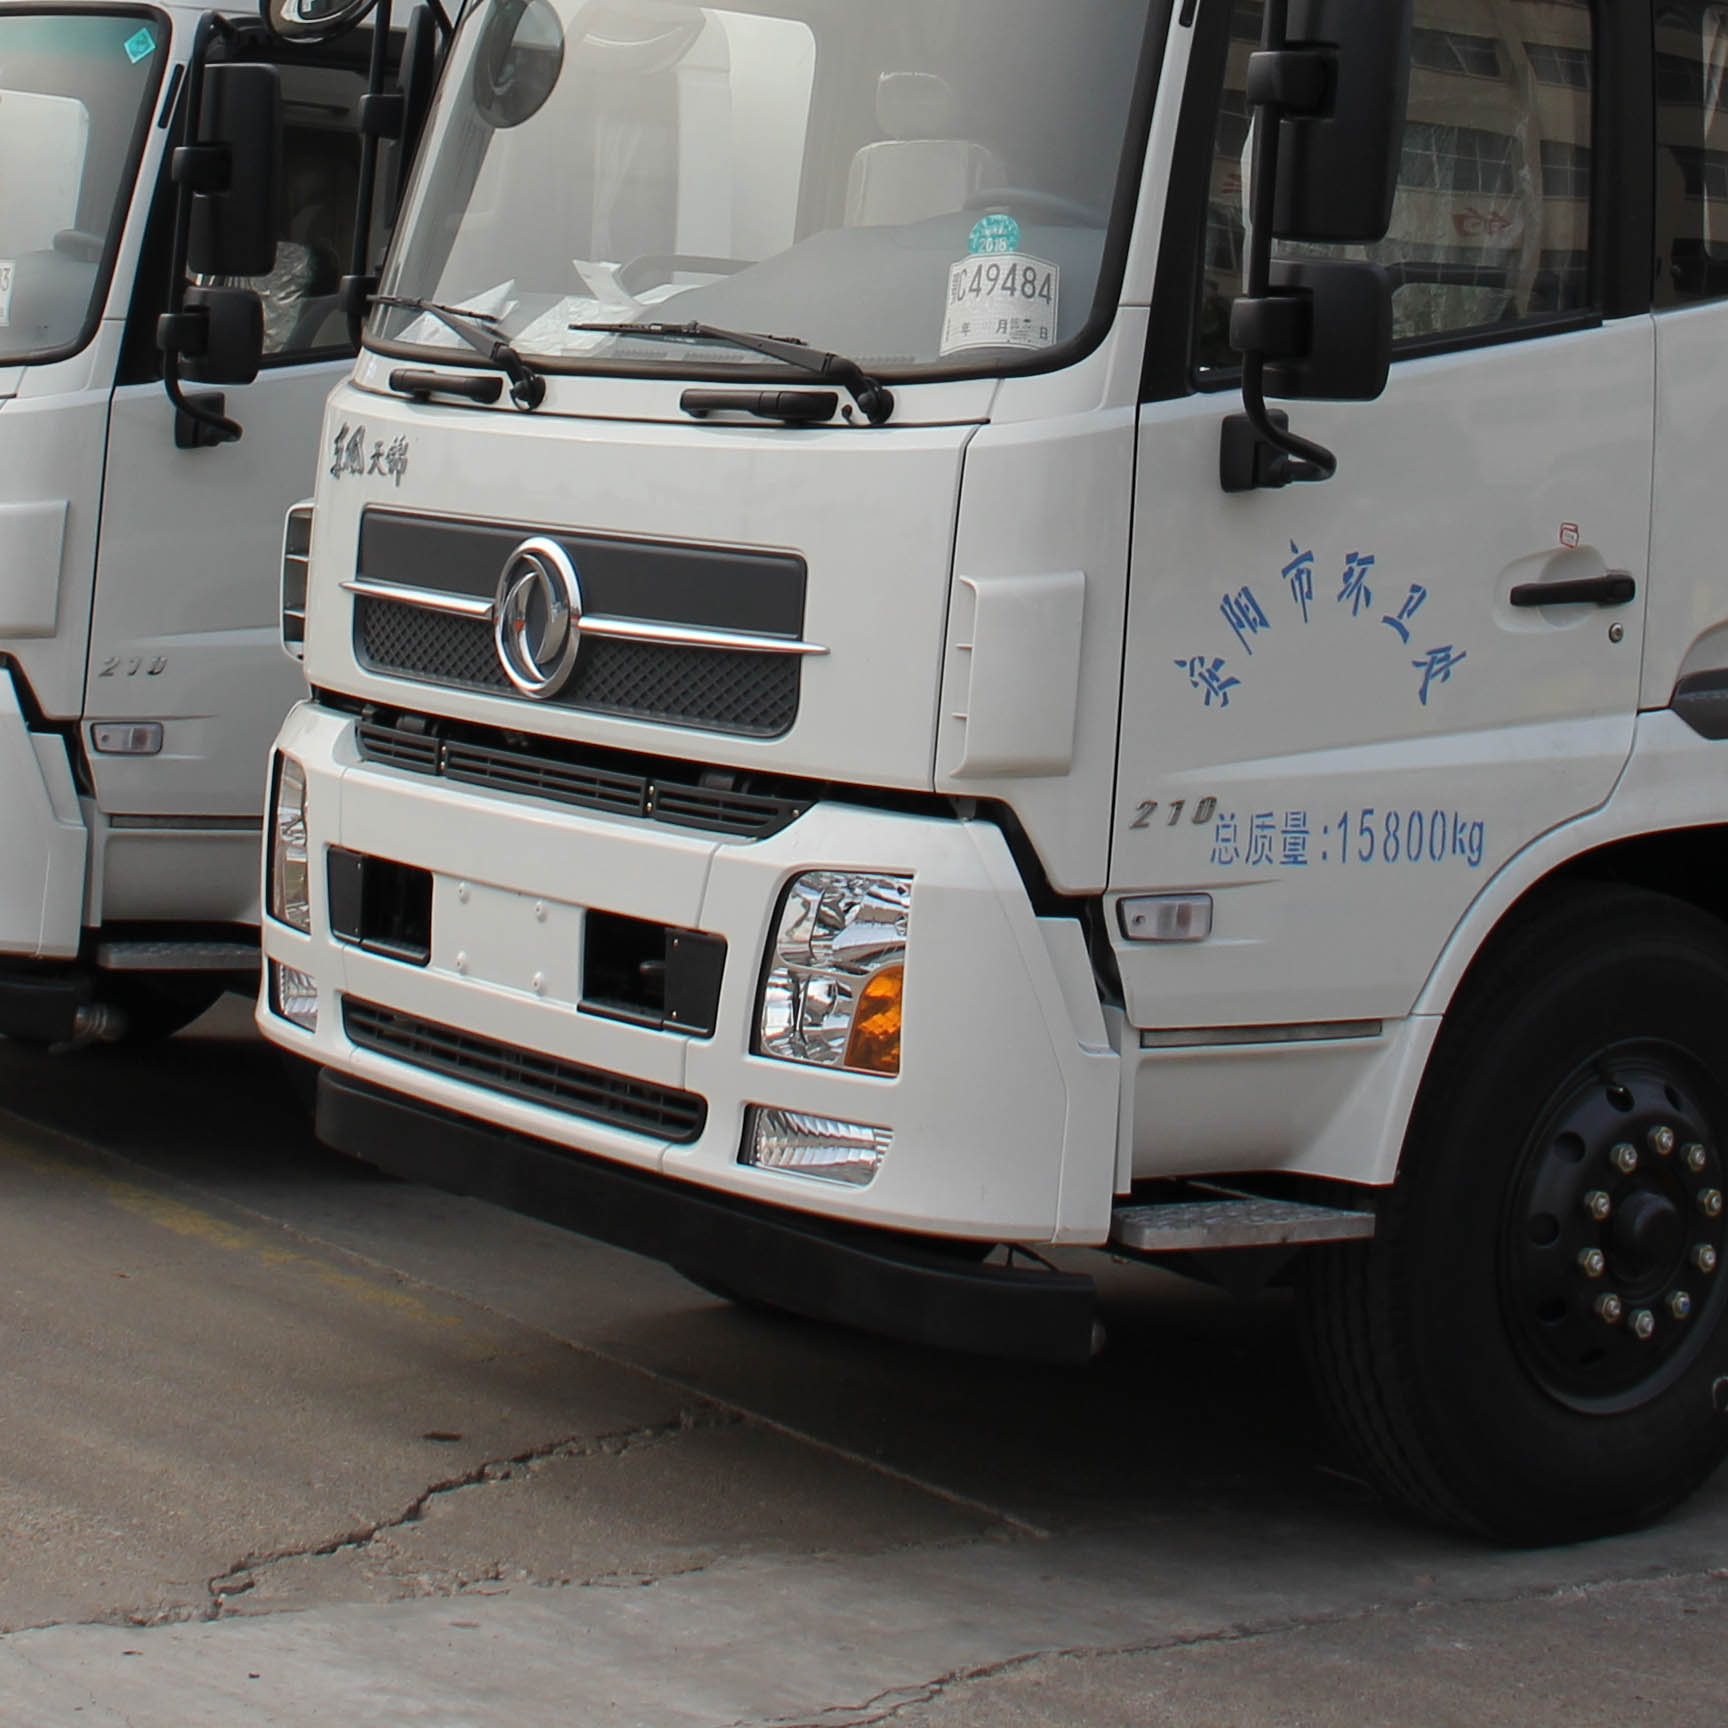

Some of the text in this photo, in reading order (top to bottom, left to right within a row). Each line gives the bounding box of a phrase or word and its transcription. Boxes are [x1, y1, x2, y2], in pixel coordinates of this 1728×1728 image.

[1173, 538, 1467, 708] 安阳市环卫处
[1129, 796, 1218, 830] 210
